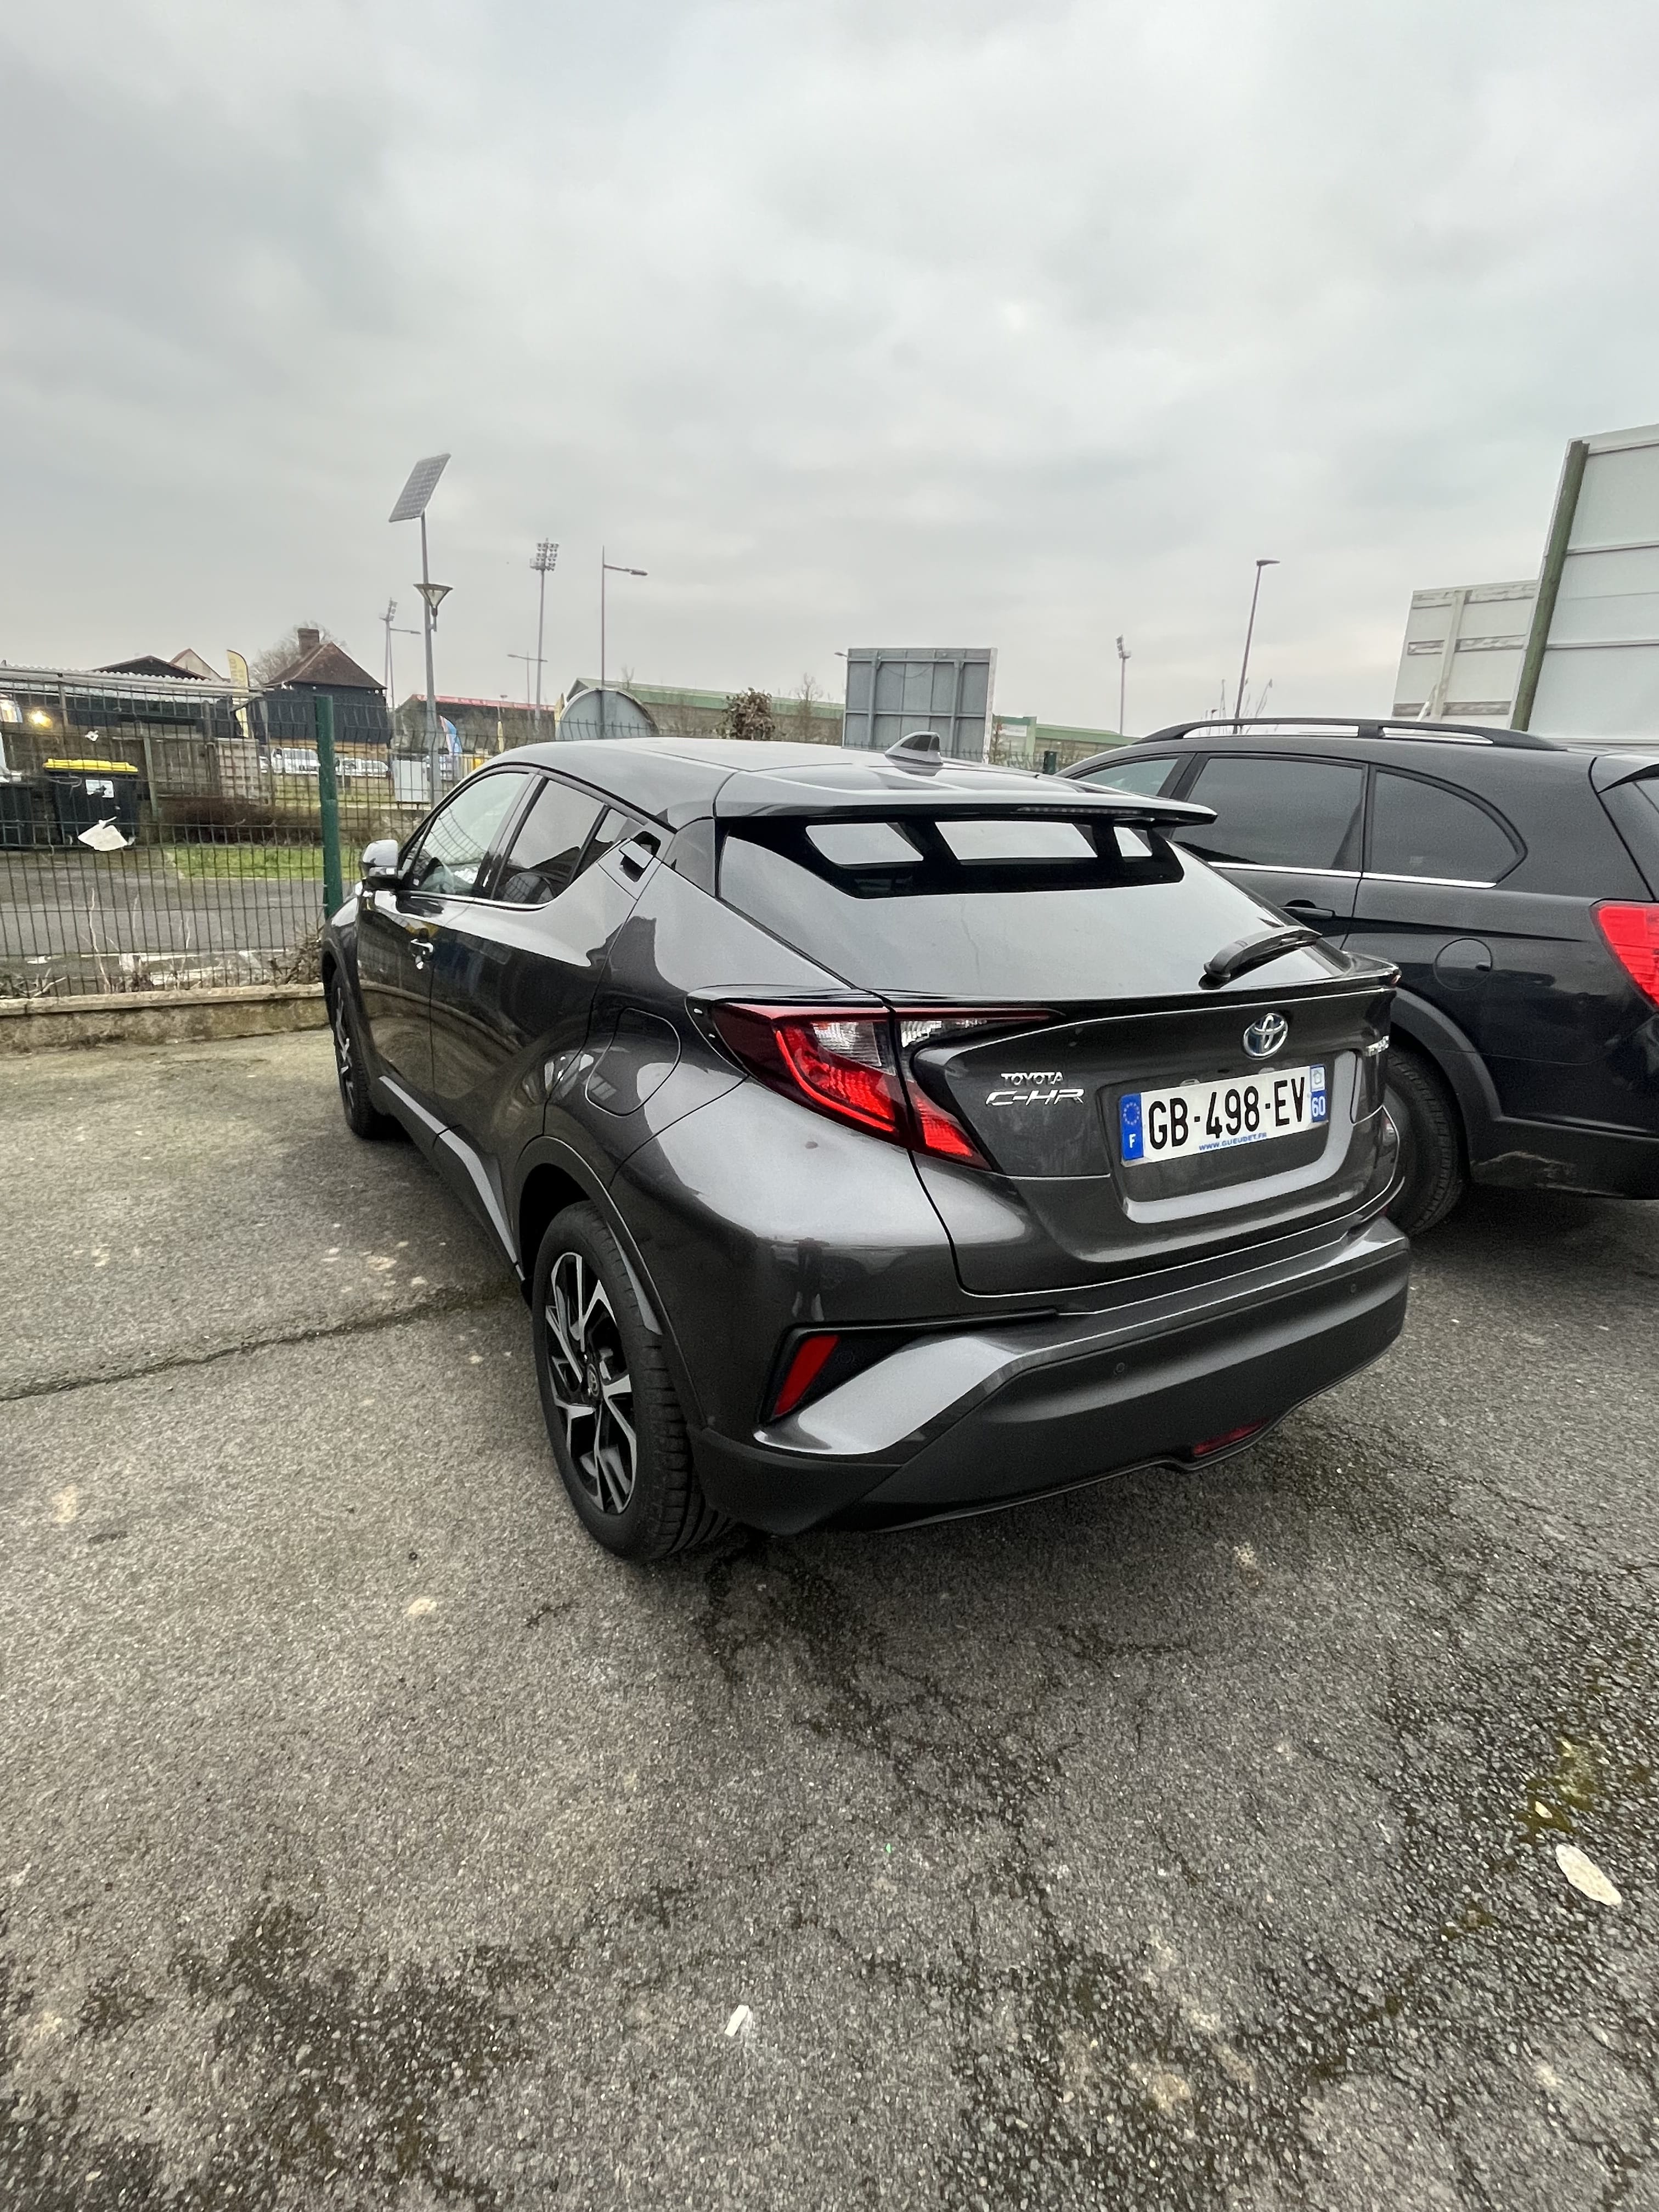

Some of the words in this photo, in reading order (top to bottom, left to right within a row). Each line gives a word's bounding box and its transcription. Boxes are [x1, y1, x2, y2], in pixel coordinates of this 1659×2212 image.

[1000, 1071, 1064, 1086] TOYOTA
[985, 1088, 1084, 1106] C-HR
[1148, 1076, 1305, 1150] GB-498-EV
[1311, 1096, 1326, 1118] 60
[1128, 1133, 1136, 1149] F
